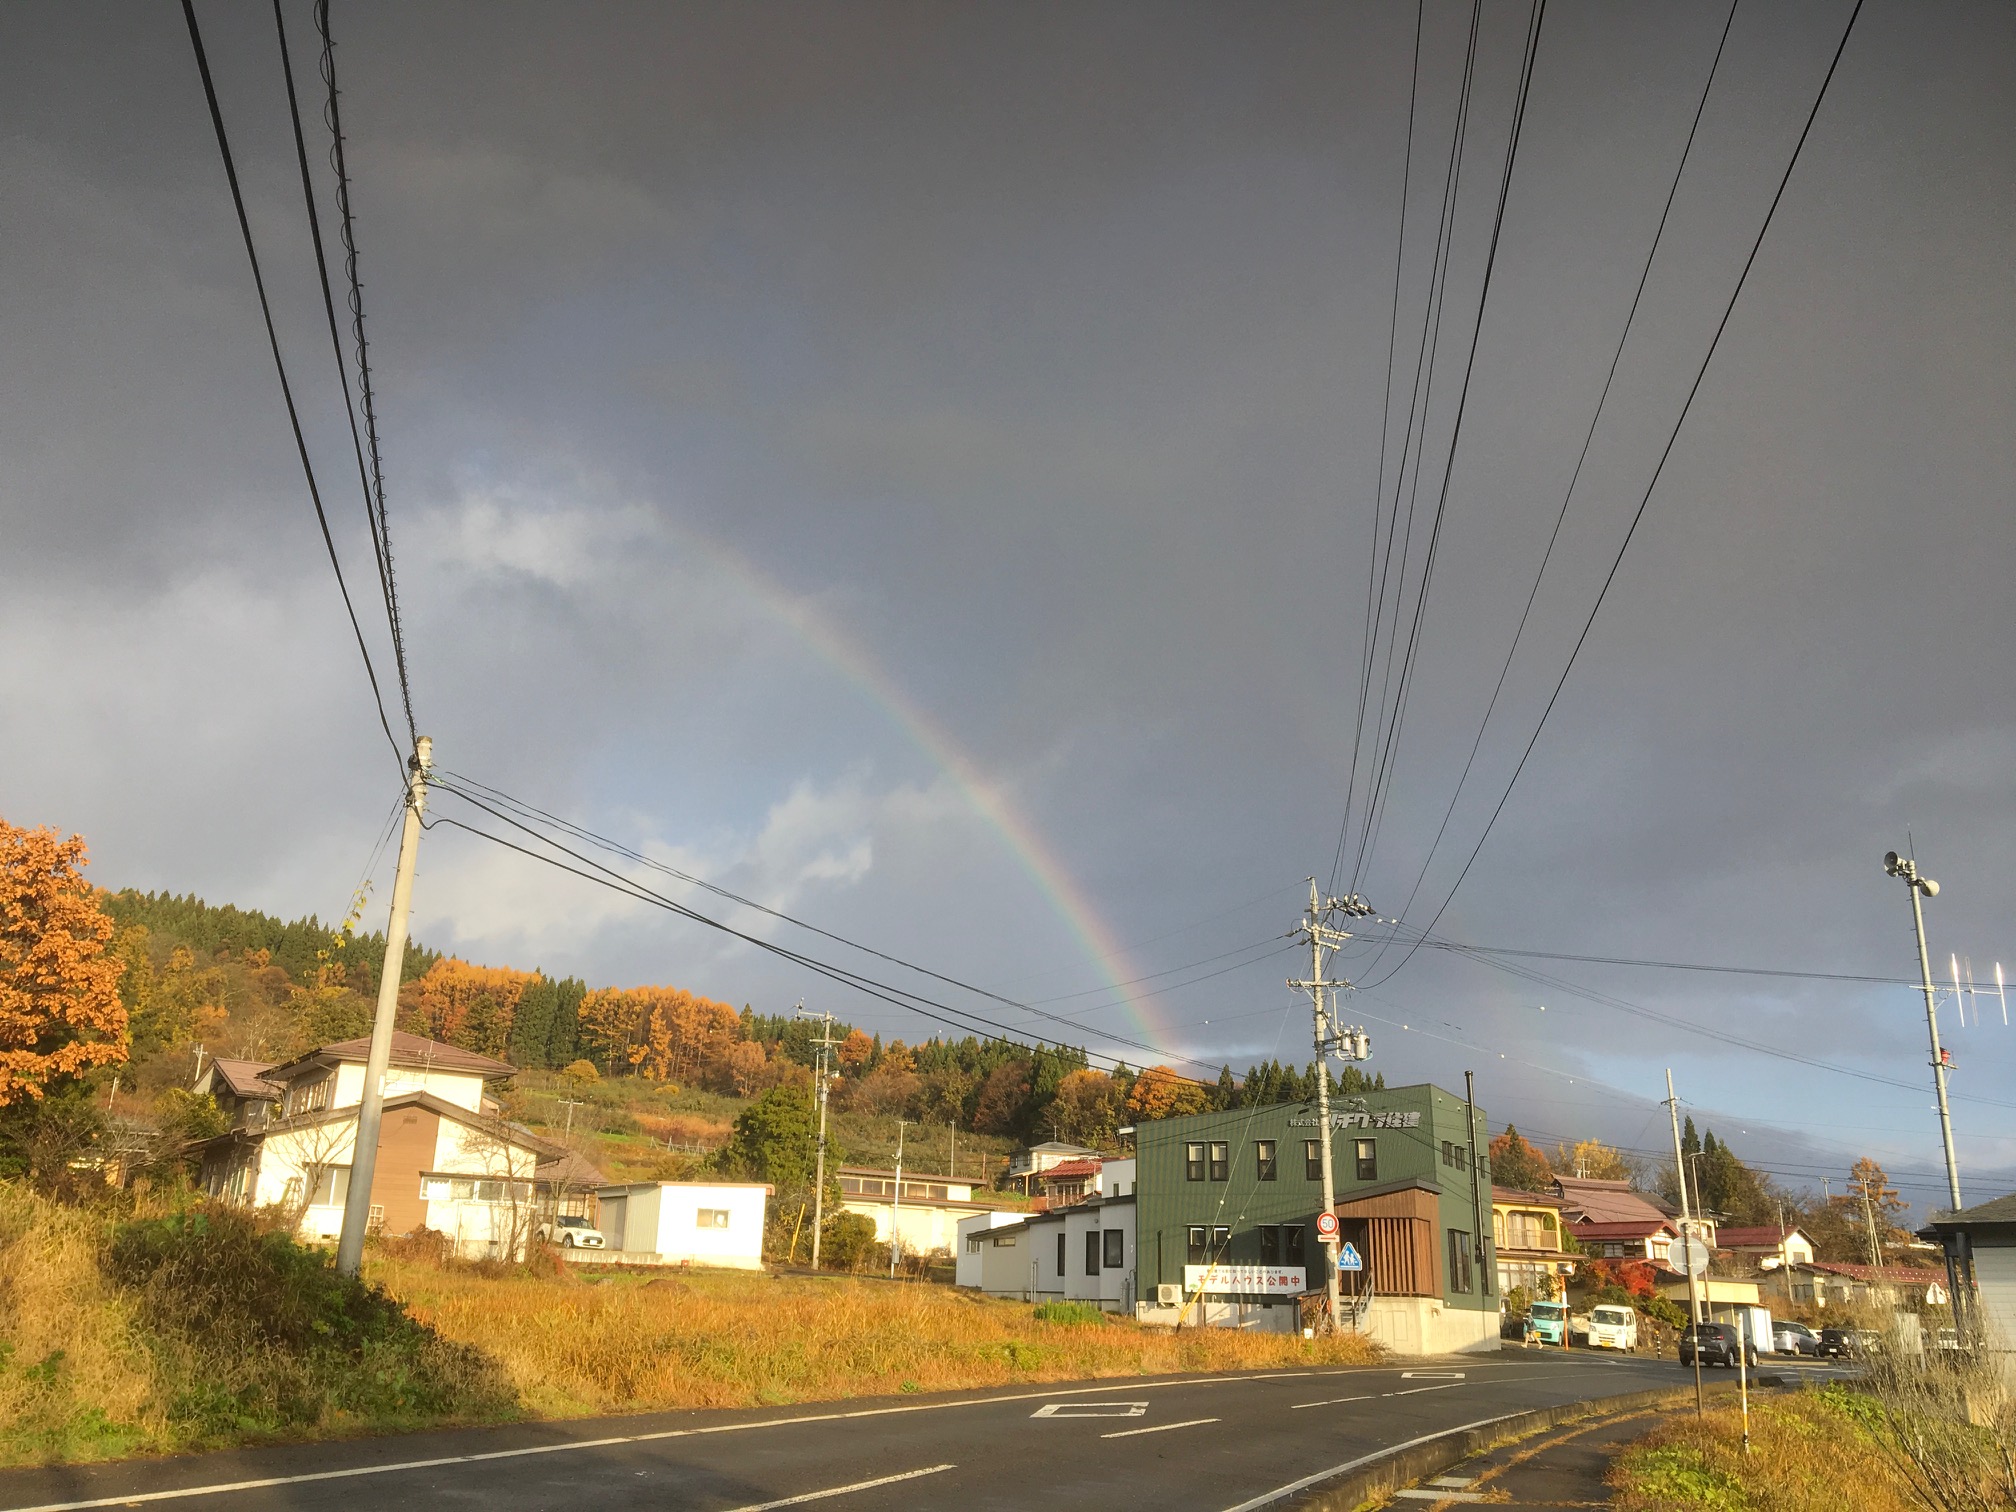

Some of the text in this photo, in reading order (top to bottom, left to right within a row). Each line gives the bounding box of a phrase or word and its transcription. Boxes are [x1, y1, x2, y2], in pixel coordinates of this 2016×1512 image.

[1322, 1218, 1334, 1229] 50
[1198, 1275, 1300, 1287] モデルハウス公開中
